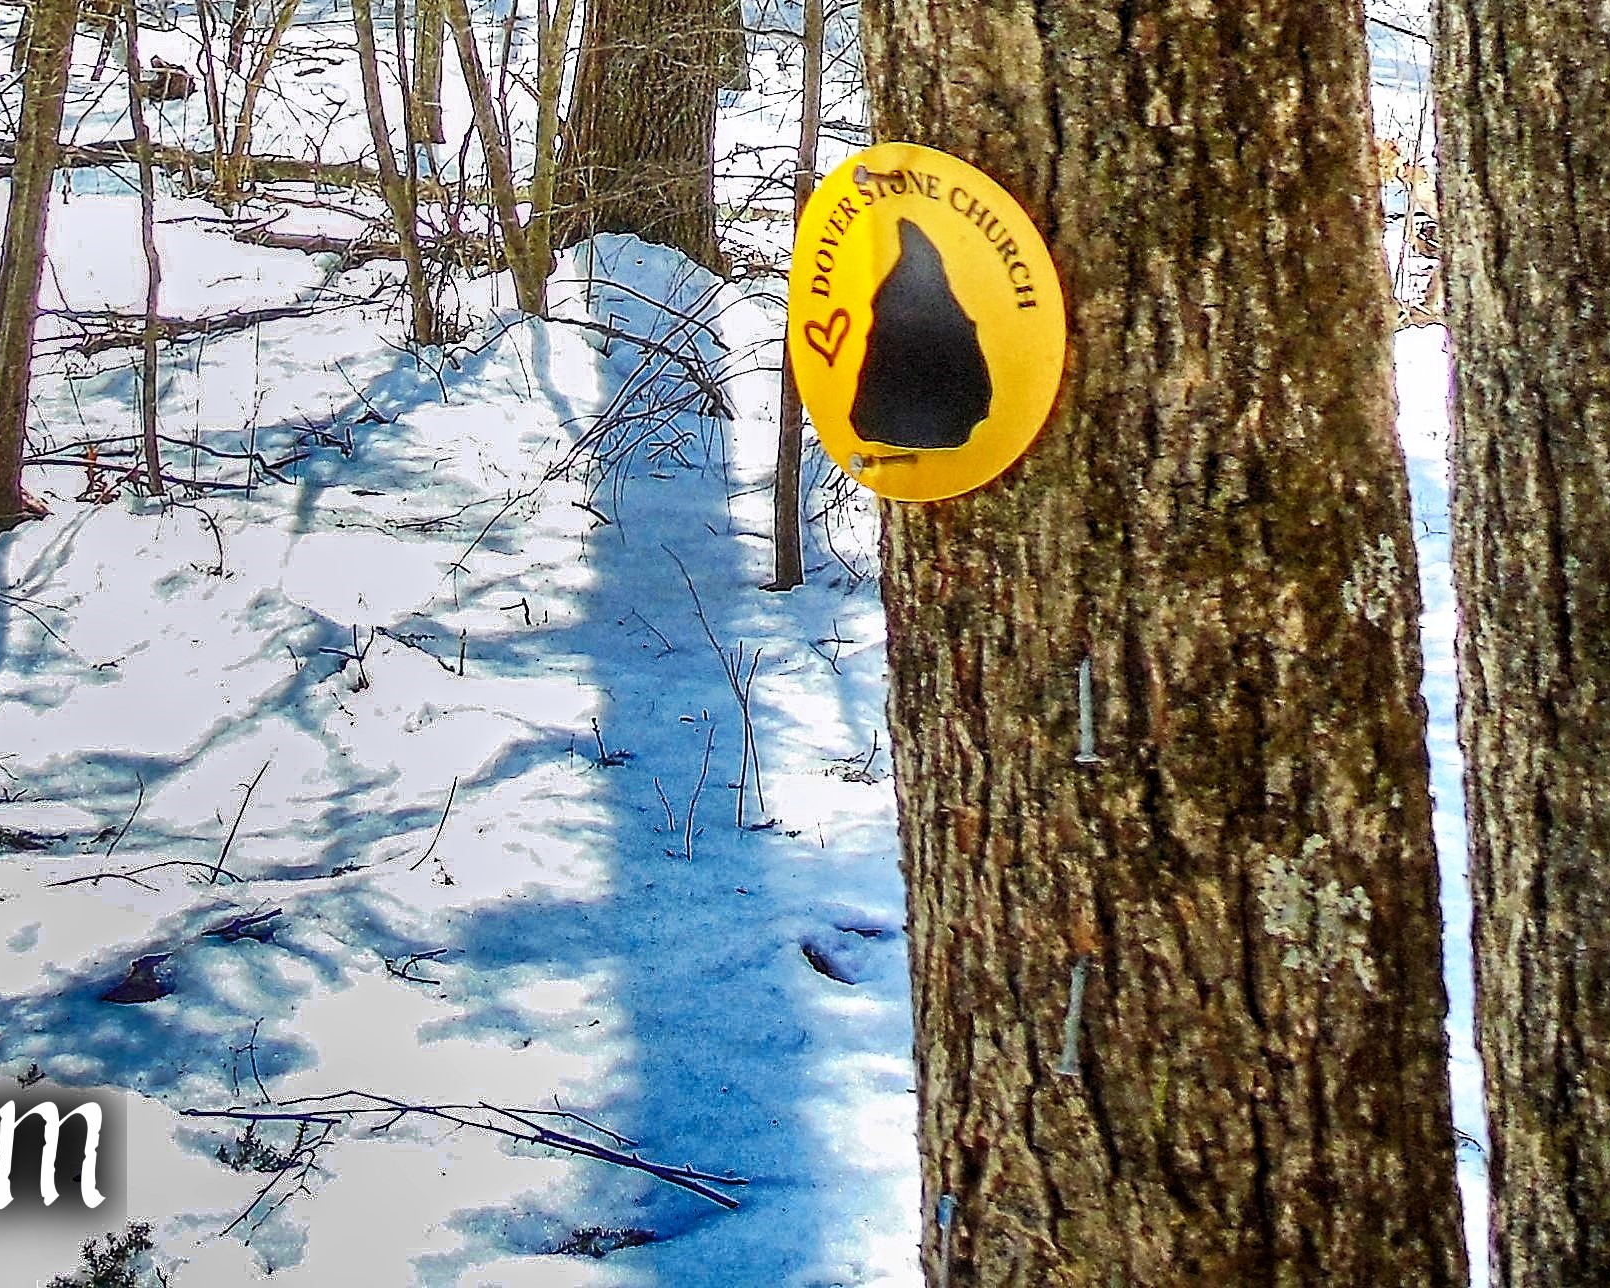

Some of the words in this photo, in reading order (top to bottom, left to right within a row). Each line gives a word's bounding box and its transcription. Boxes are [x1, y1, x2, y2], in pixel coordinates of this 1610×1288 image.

[811, 197, 860, 298] DOVER
[858, 169, 941, 206] STONE
[947, 185, 1037, 311] CHURCH
